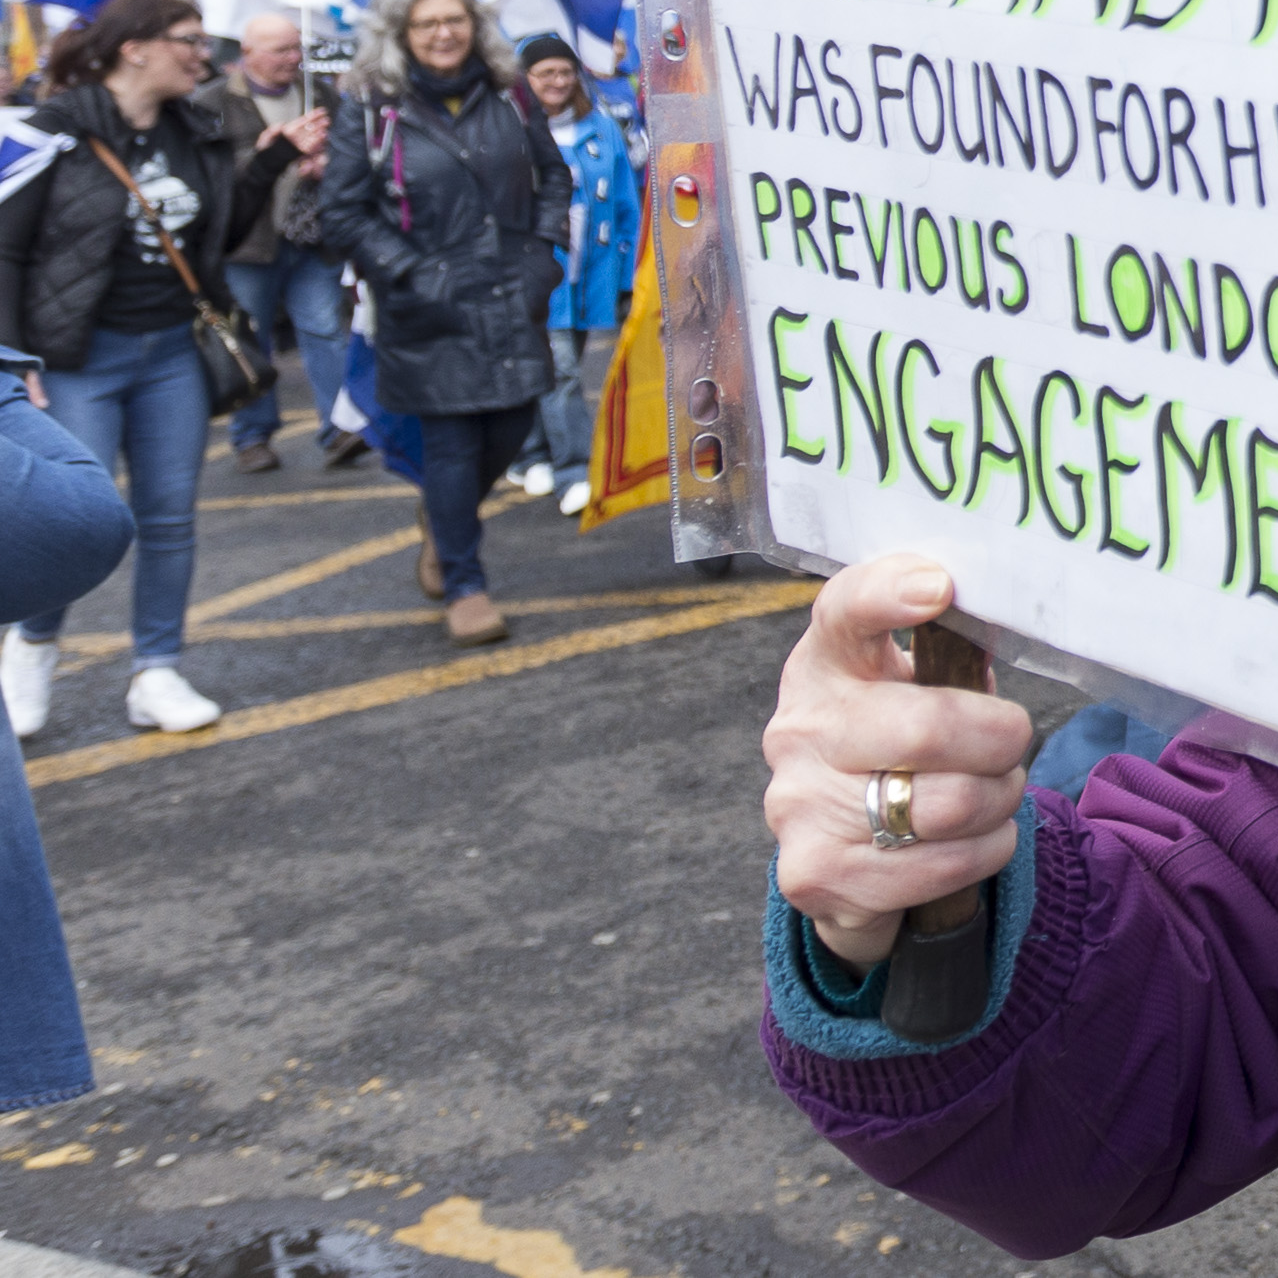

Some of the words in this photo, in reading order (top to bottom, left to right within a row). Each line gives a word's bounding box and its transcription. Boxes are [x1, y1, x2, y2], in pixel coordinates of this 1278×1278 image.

[725, 23, 863, 144] WAS
[868, 42, 1081, 192] FOUND
[1090, 76, 1211, 204] FOR
[747, 170, 1030, 316] PREVIOUS
